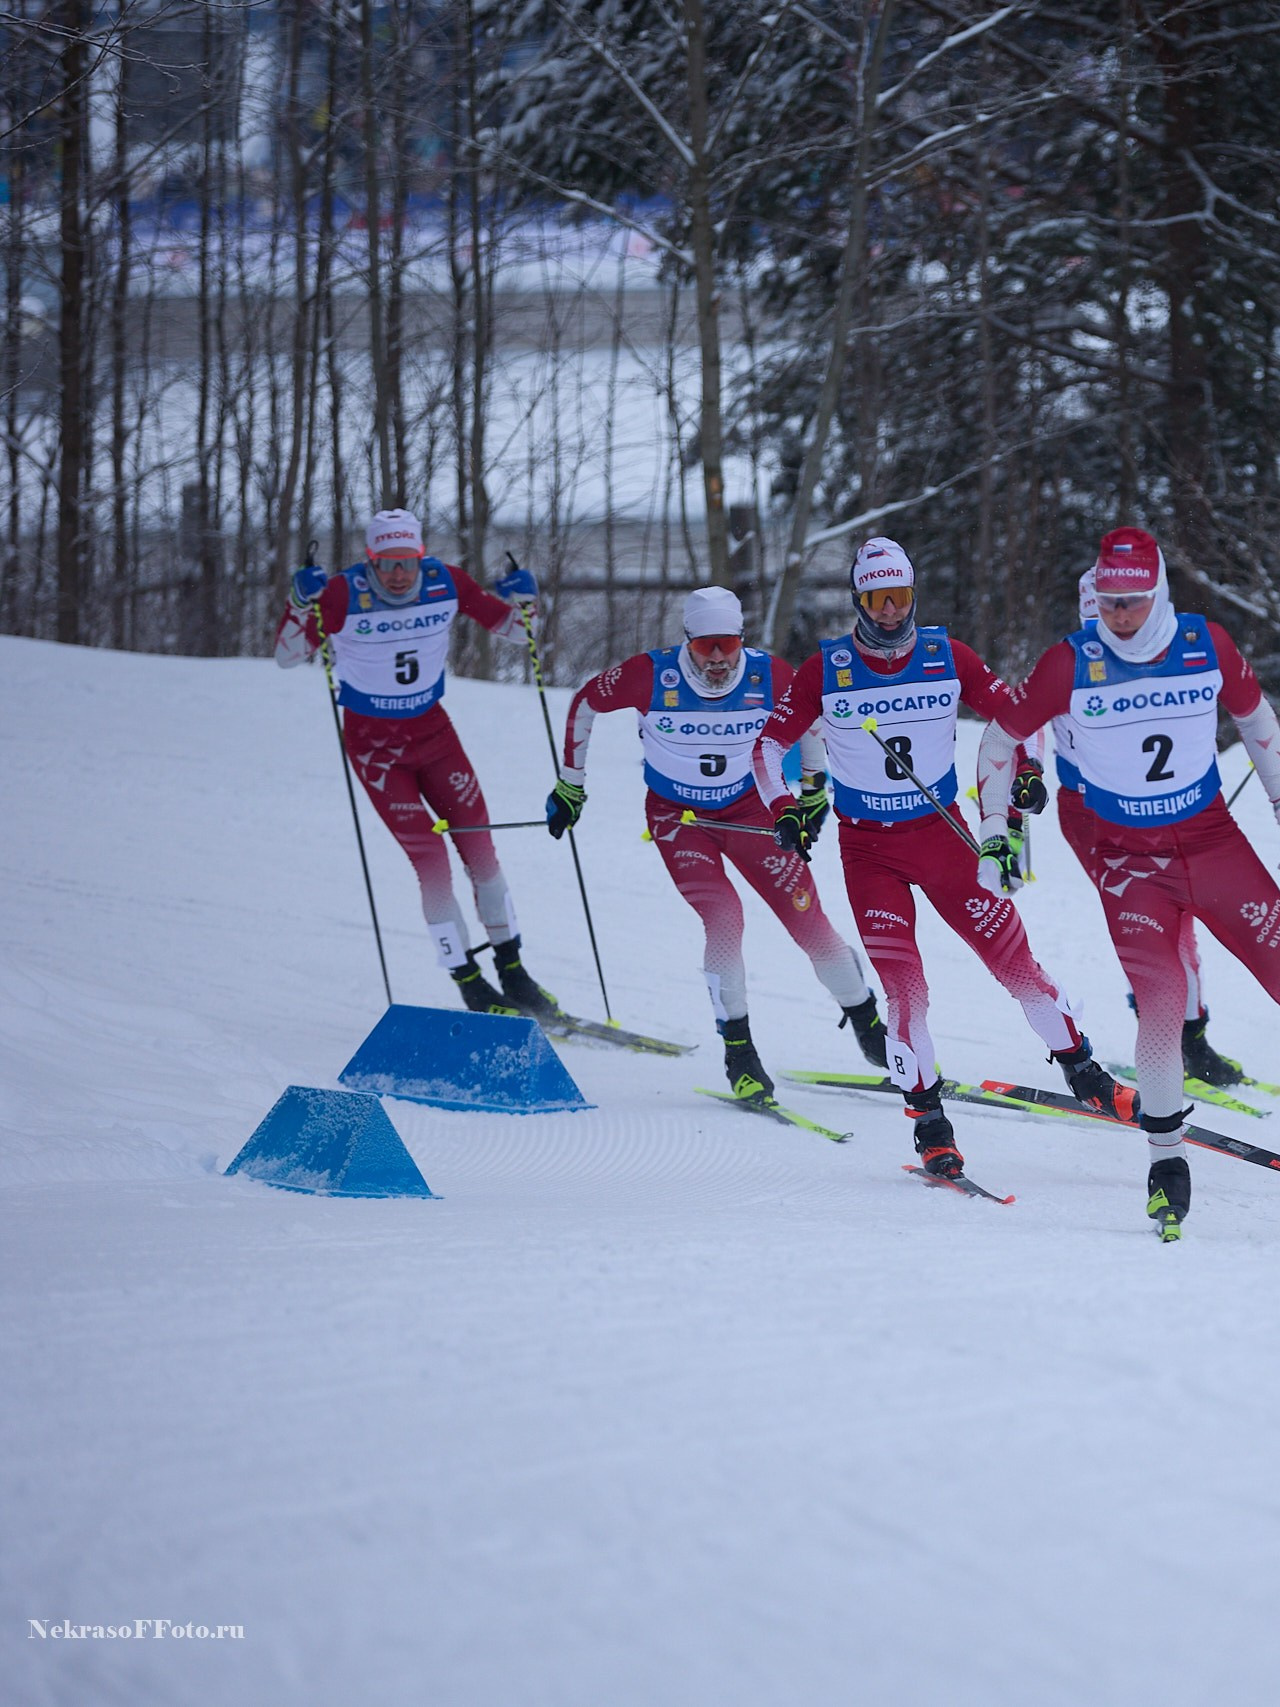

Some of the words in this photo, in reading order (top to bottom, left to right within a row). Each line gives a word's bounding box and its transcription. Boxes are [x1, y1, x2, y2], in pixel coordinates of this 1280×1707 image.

[858, 567, 903, 585] ЛУКОЙЛ
[1103, 566, 1151, 578] ЛУКОЙЛ
[395, 649, 419, 685] 5
[857, 693, 952, 716] ФОСАГРО
[1112, 686, 1214, 713] ФОСАГРО
[680, 718, 766, 736] ФОСАГРО
[884, 735, 913, 781] 8
[1141, 733, 1175, 782] 2
[672, 779, 746, 802] ЧЕПЕЦКОЕ
[1117, 783, 1202, 816] ЧЕПЕЦКОЕ
[864, 908, 910, 928] ЛУКОЙЛ
[974, 896, 1005, 932] ФОСАГРО
[984, 903, 1012, 939] BIVIUM
[1117, 911, 1165, 933] ЛУКОЙЛ
[440, 936, 452, 956] 5
[894, 1054, 906, 1075] 8
